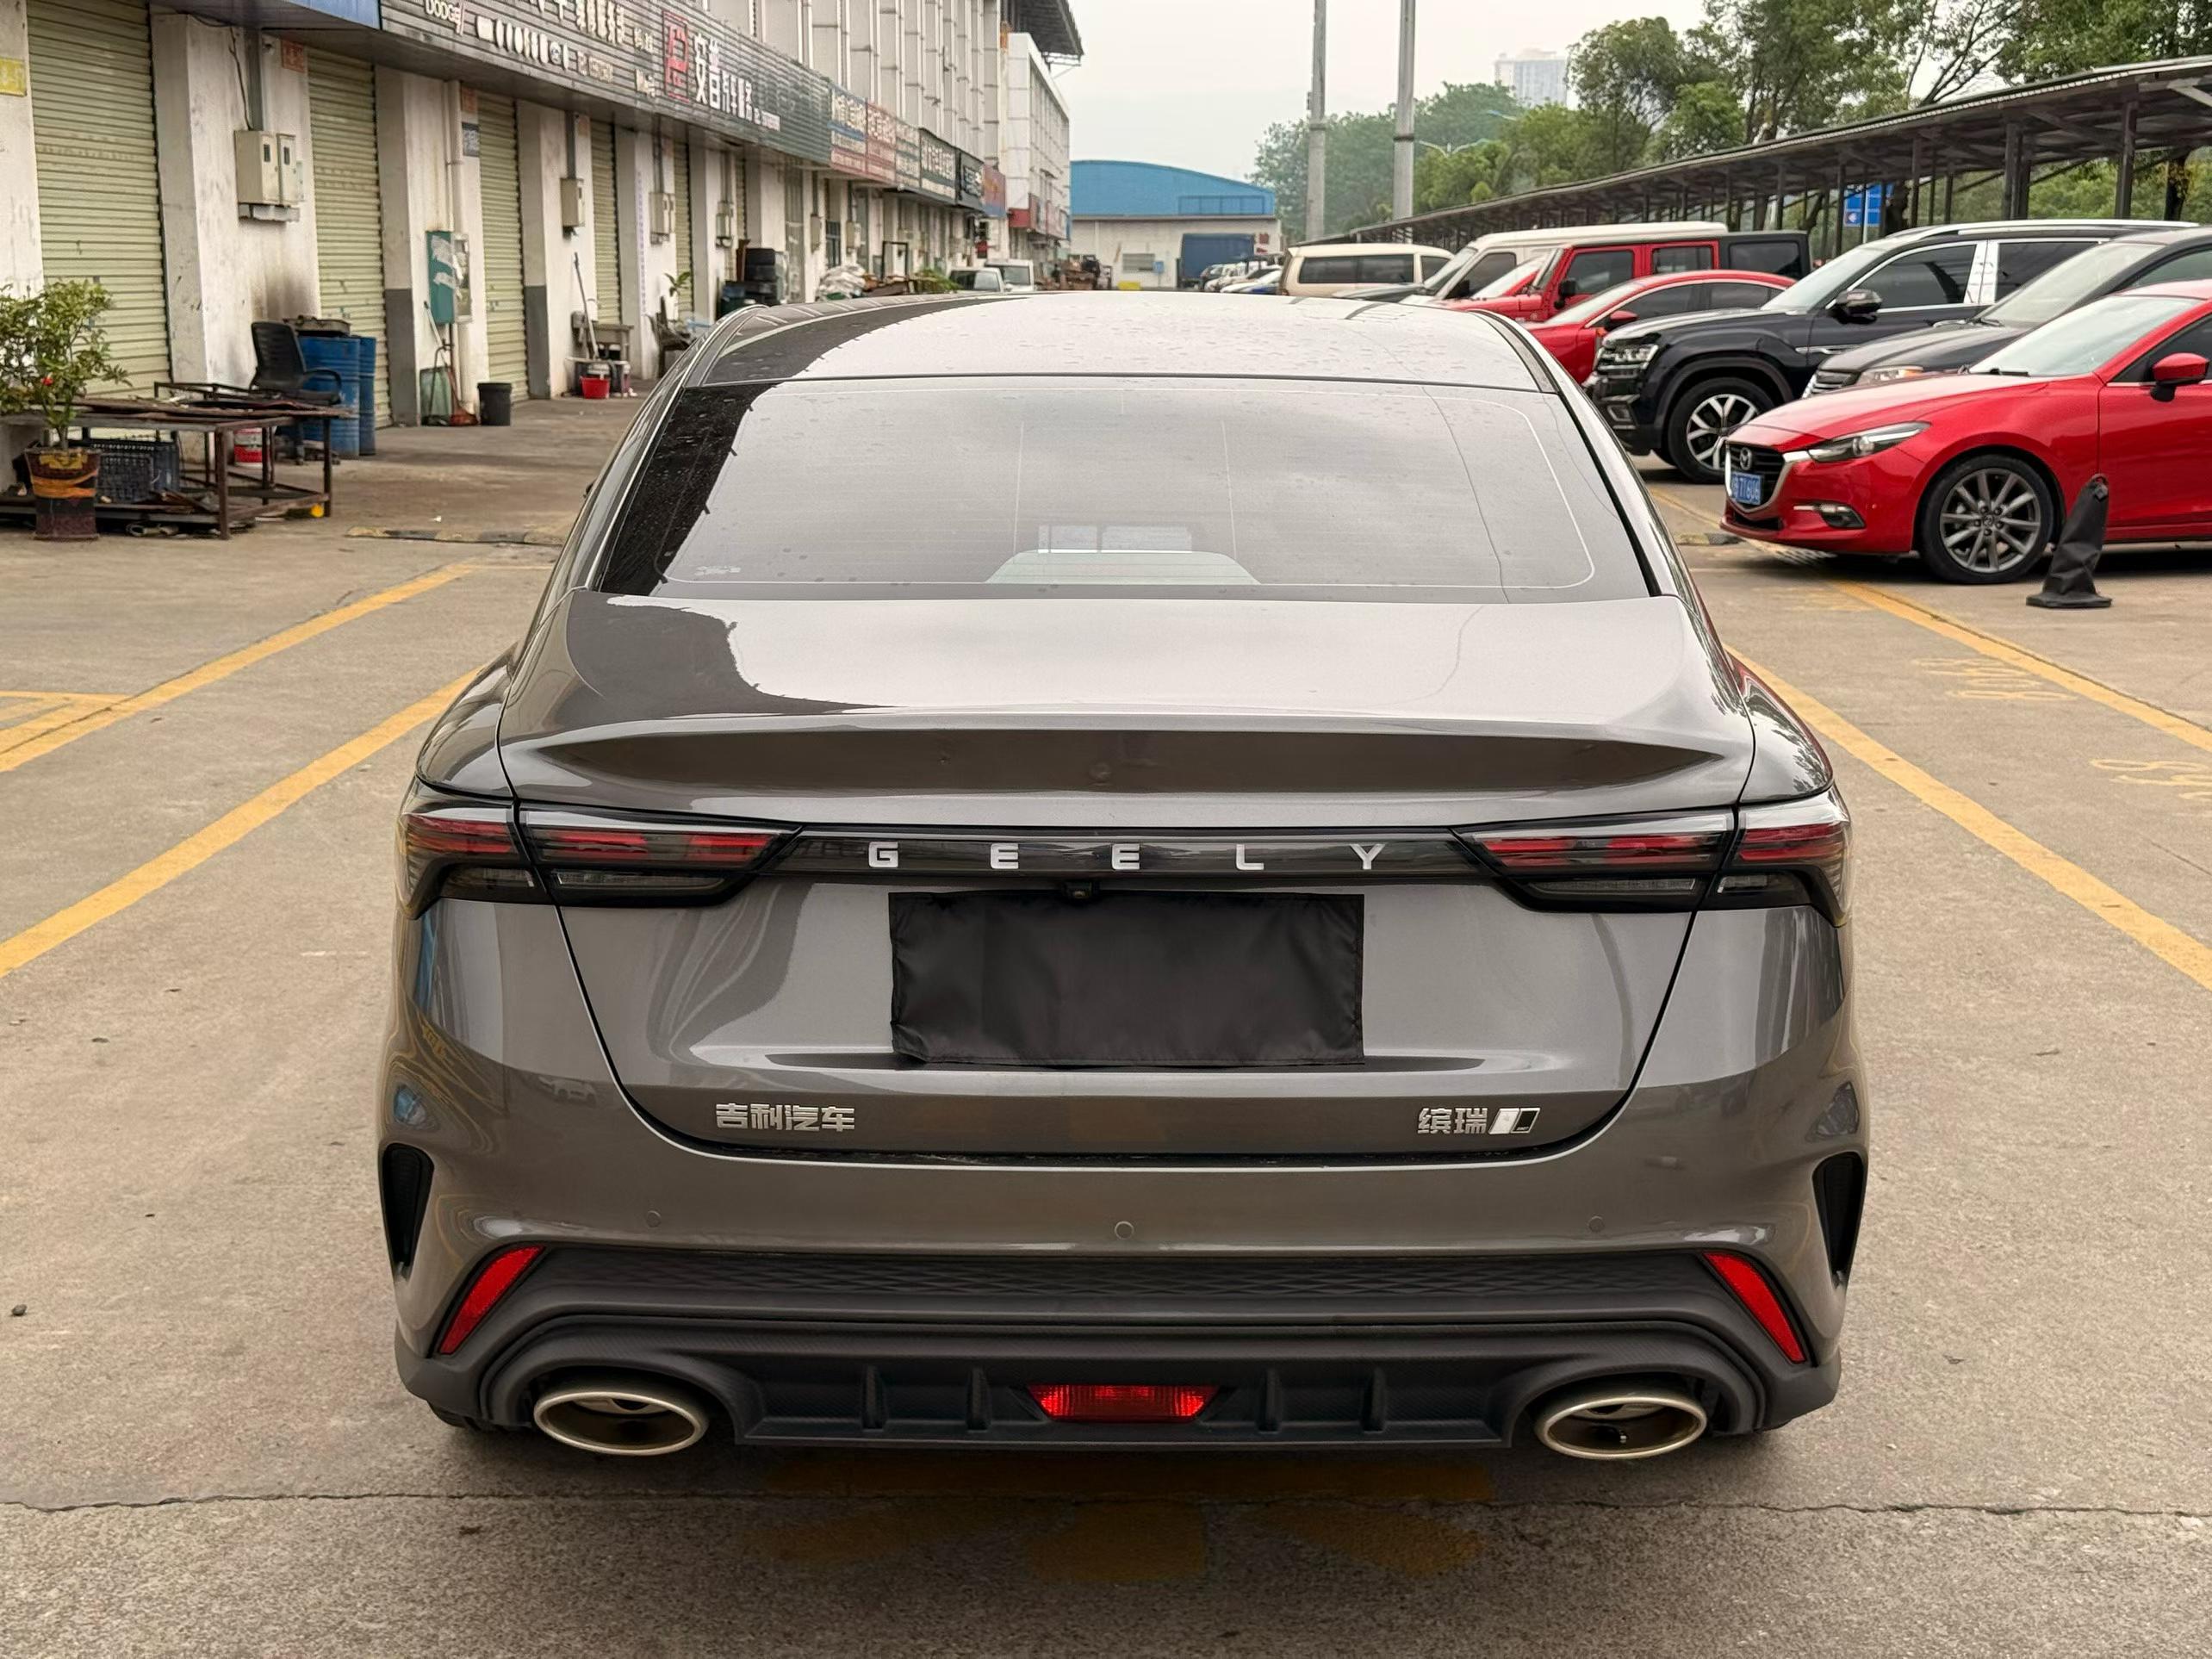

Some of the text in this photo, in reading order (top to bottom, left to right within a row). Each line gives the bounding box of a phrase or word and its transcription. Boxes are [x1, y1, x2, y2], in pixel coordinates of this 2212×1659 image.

[868, 841, 1385, 871] GEELY
[716, 1103, 855, 1132] 吉利汽车
[1417, 1107, 1488, 1134] 缤瑞
